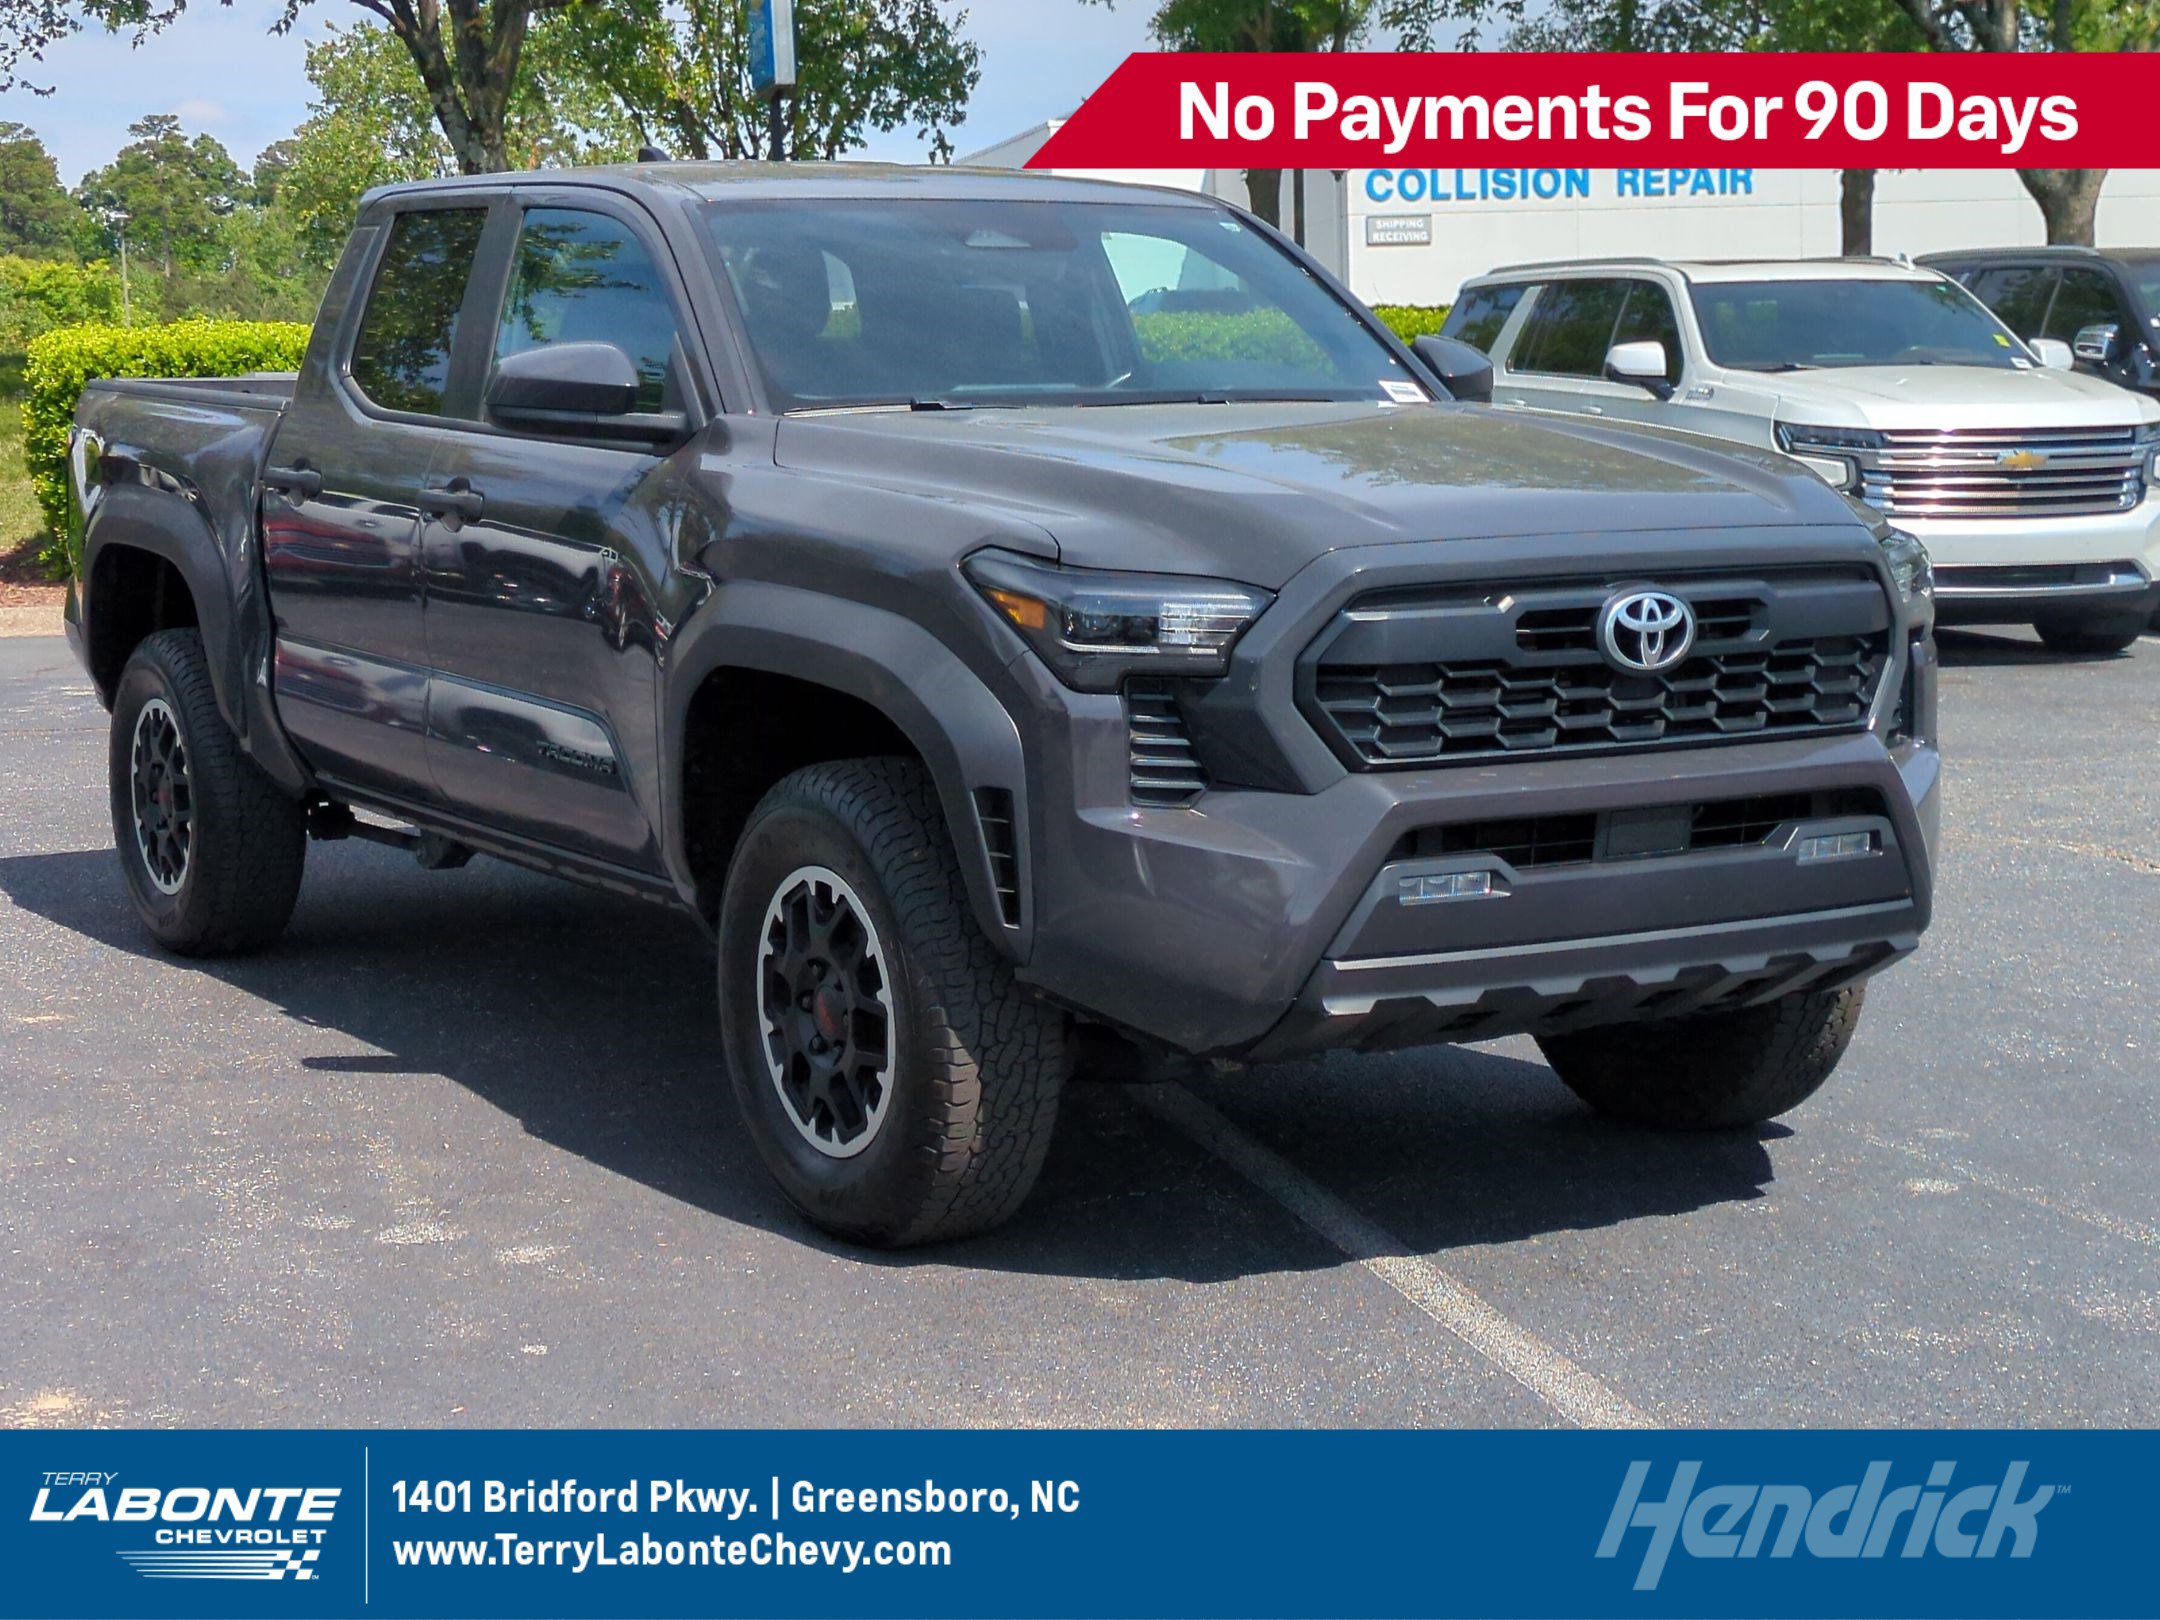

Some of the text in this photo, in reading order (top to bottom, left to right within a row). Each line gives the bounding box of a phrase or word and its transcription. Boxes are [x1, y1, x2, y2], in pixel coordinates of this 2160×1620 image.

[1365, 168, 1753, 201] COLLISION REPAIR
[1375, 218, 1424, 230] SHIPPING
[1372, 230, 1429, 242] RECEIVING
